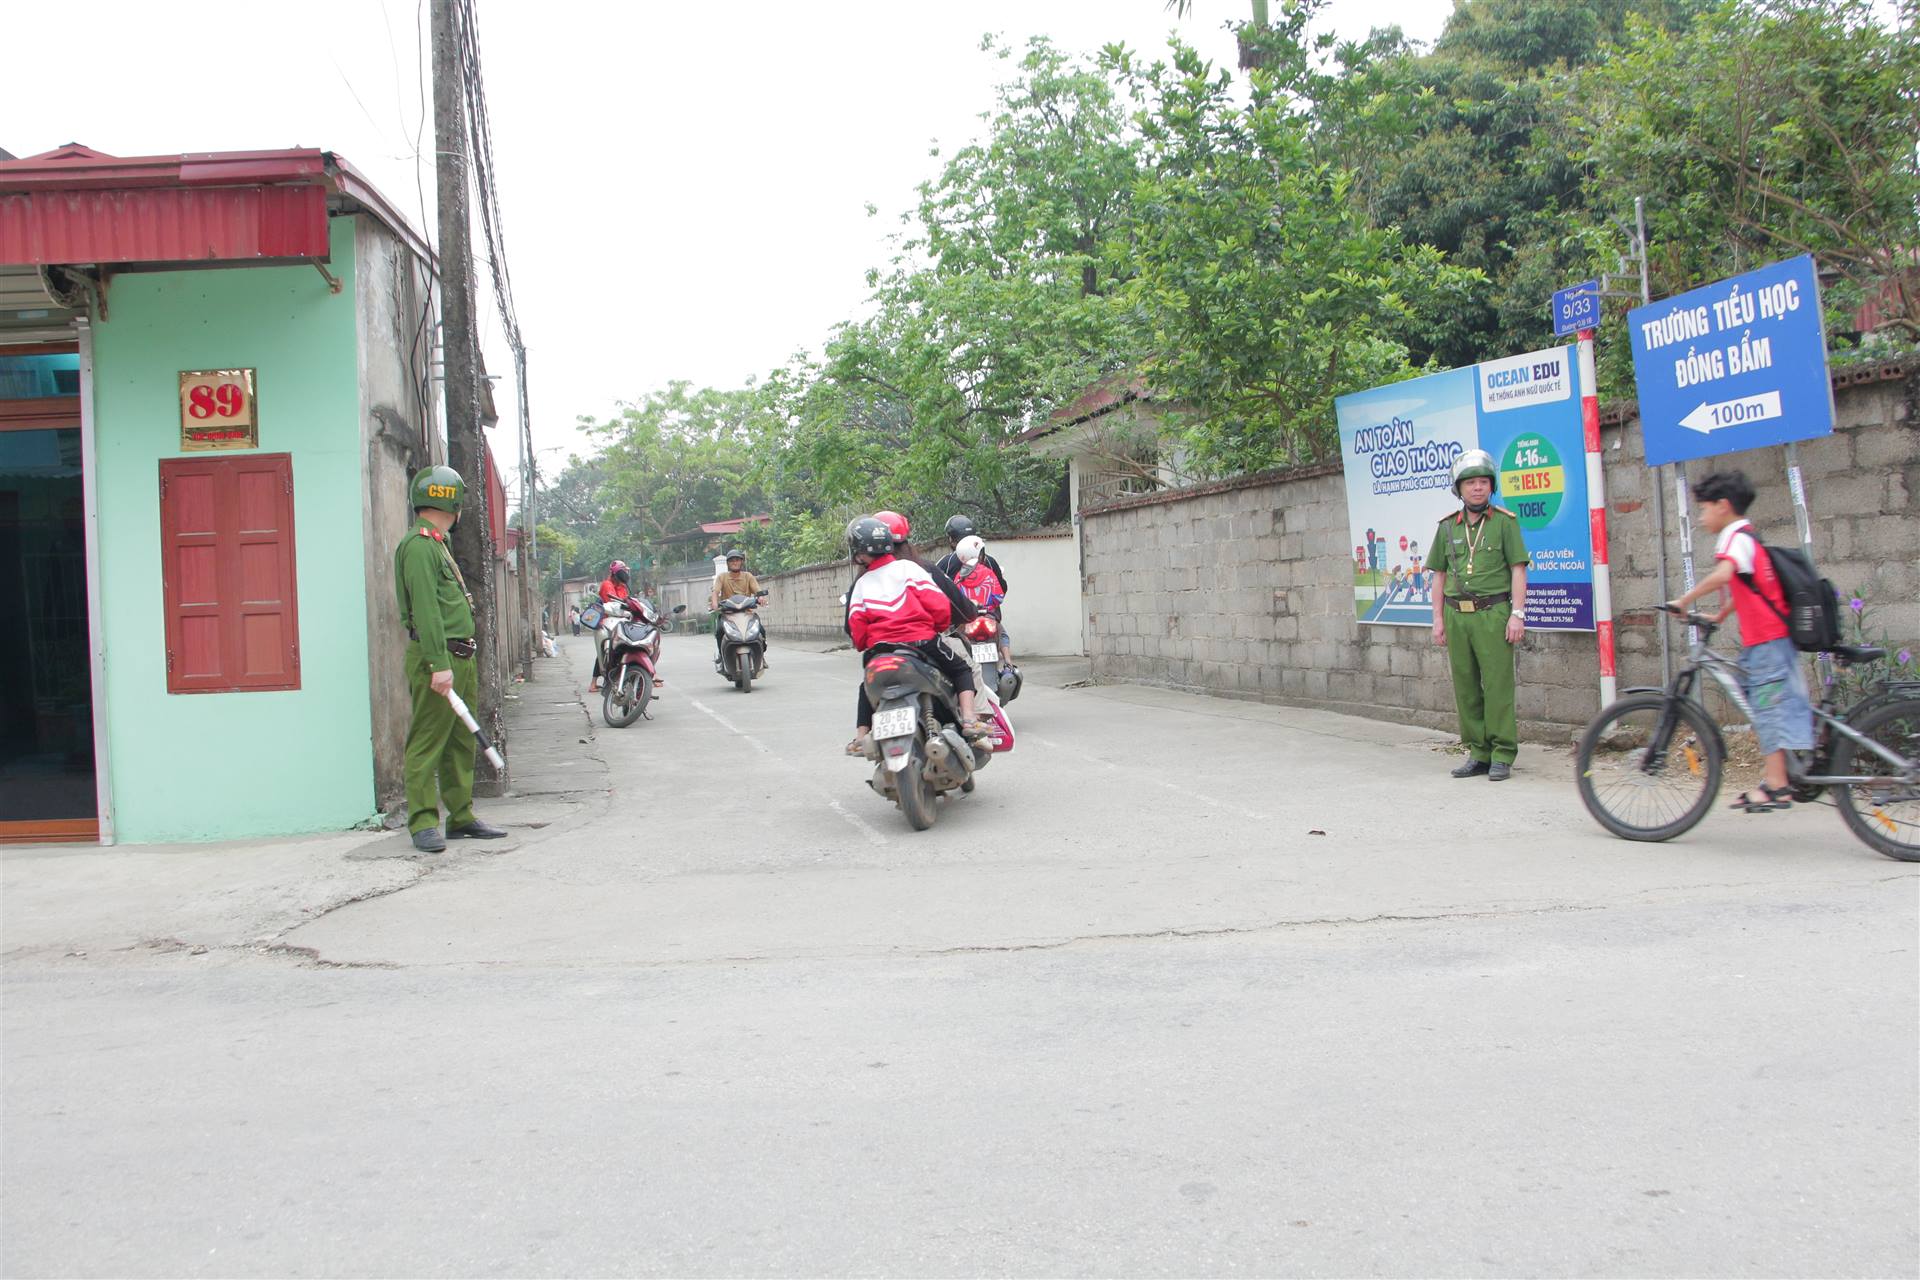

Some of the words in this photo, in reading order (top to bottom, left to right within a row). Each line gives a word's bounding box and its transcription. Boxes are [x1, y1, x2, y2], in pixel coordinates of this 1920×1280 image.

[1562, 298, 1590, 319] 9/33
[1642, 305, 1710, 350] TRƯỜNG
[1713, 284, 1755, 331] TIỂU
[1758, 279, 1800, 321] HỌC
[1675, 346, 1725, 388] ĐỒNG
[1727, 329, 1772, 376] BẨM
[1487, 367, 1530, 389] OCEAN
[1533, 360, 1560, 381] EDU
[189, 384, 243, 419] 89
[1496, 389, 1514, 401] THỐNG
[1514, 387, 1526, 398] ANH
[1539, 381, 1554, 394] QUỐC
[1711, 402, 1764, 425] 100m
[1355, 428, 1375, 454] AN
[1374, 417, 1414, 450] TOÀN
[1371, 450, 1408, 478] GIAO
[1515, 448, 1539, 468] 4-16
[428, 484, 457, 499] CSTT
[1373, 480, 1382, 495] LÀ
[1382, 479, 1400, 496] HẠNH
[1400, 476, 1419, 492] PHÚC
[1419, 475, 1434, 490] CHO
[1434, 474, 1449, 490] MỌI
[1521, 472, 1551, 490] IELTS
[1518, 501, 1547, 518] TOEIC
[1536, 549, 1555, 559] GIÁO
[1556, 548, 1574, 559] VIÊN
[1537, 560, 1559, 571] NƯỚC
[1560, 560, 1585, 571] NGOÀI
